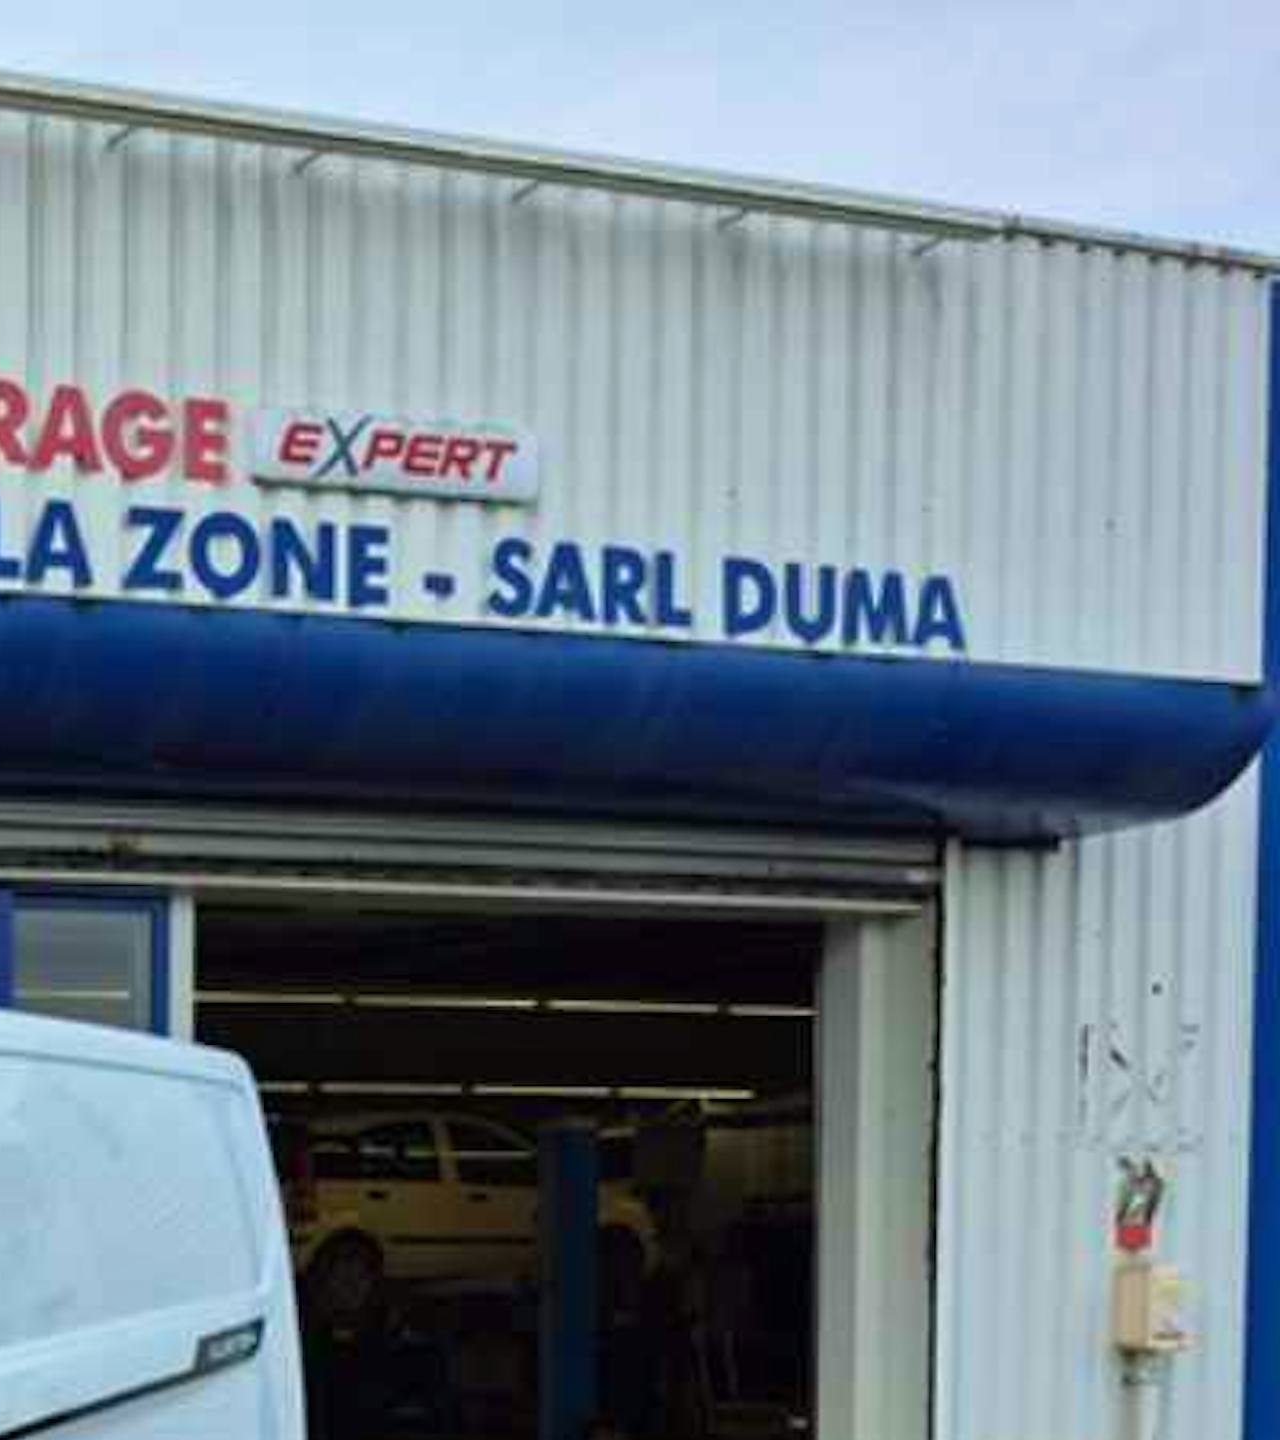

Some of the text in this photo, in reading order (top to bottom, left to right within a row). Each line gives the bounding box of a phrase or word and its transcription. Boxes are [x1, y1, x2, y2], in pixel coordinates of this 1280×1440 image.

[278, 417, 517, 482] EXPERT
[121, 506, 390, 608] ZONE
[487, 538, 692, 628] SARL
[722, 557, 966, 651] DUMA
